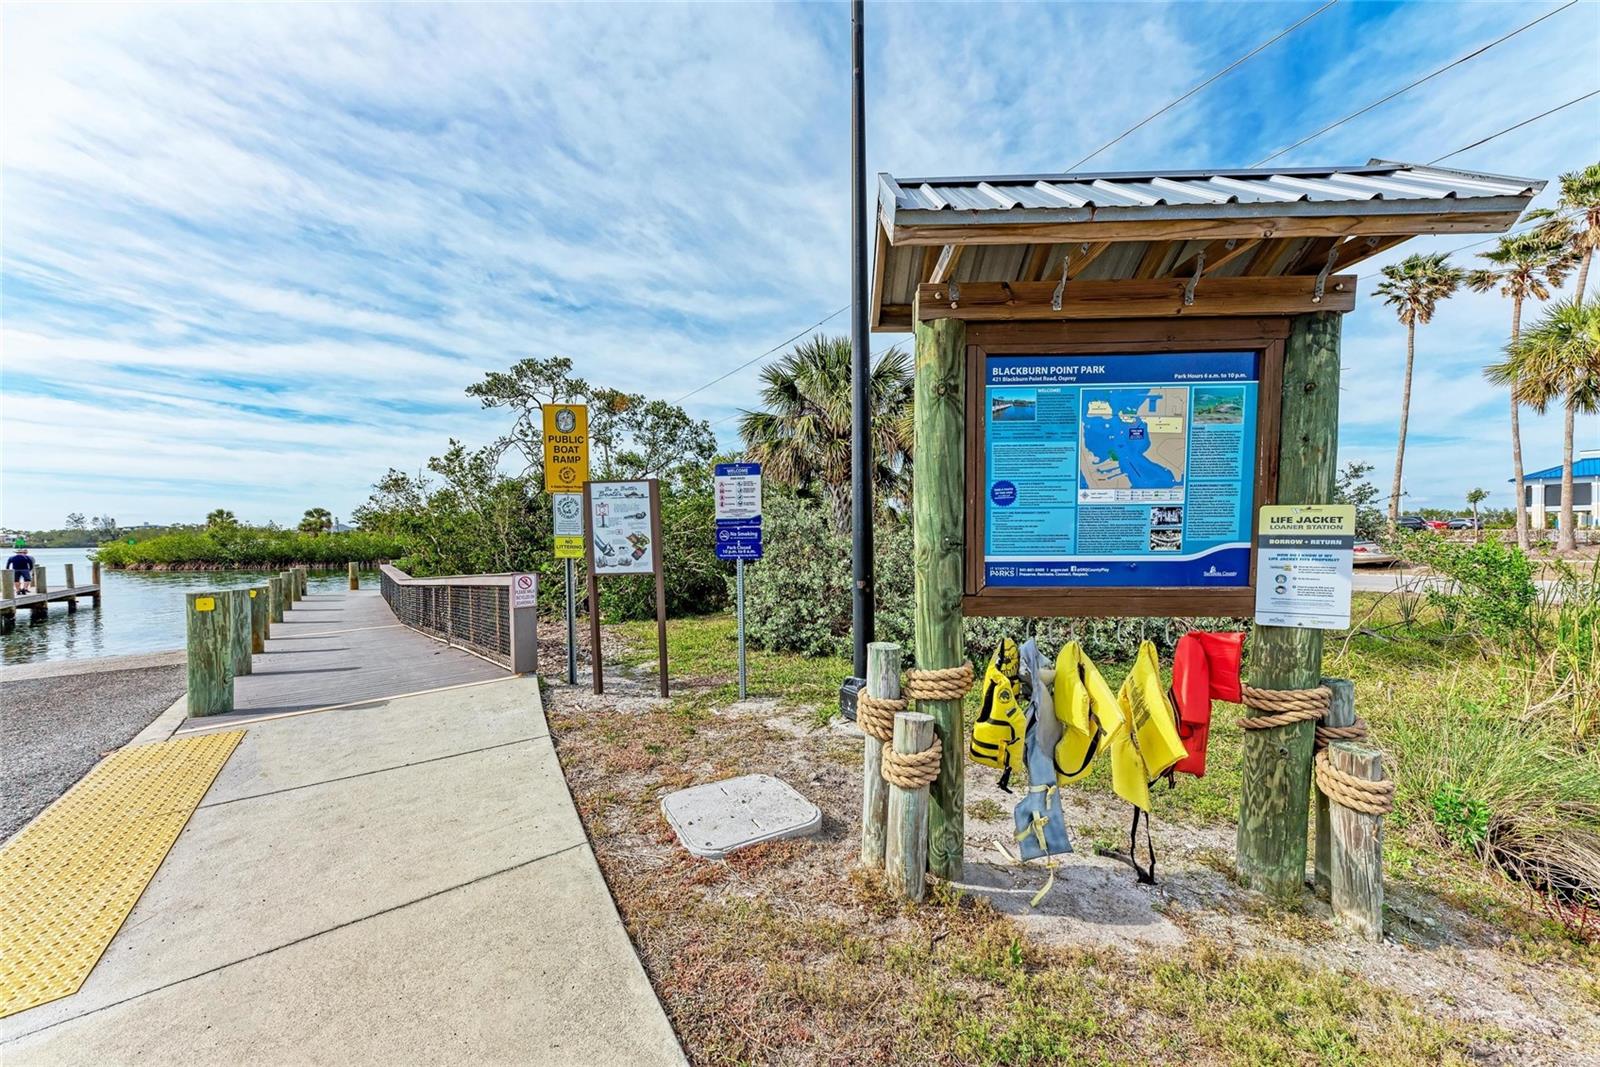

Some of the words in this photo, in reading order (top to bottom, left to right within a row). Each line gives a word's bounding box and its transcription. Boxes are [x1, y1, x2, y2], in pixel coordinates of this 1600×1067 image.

[992, 367, 1048, 376] BLACKBURN
[1050, 366, 1079, 375] POINT
[1081, 365, 1105, 374] PARK
[548, 435, 584, 443] PUBLIC
[553, 455, 581, 463] RAMP
